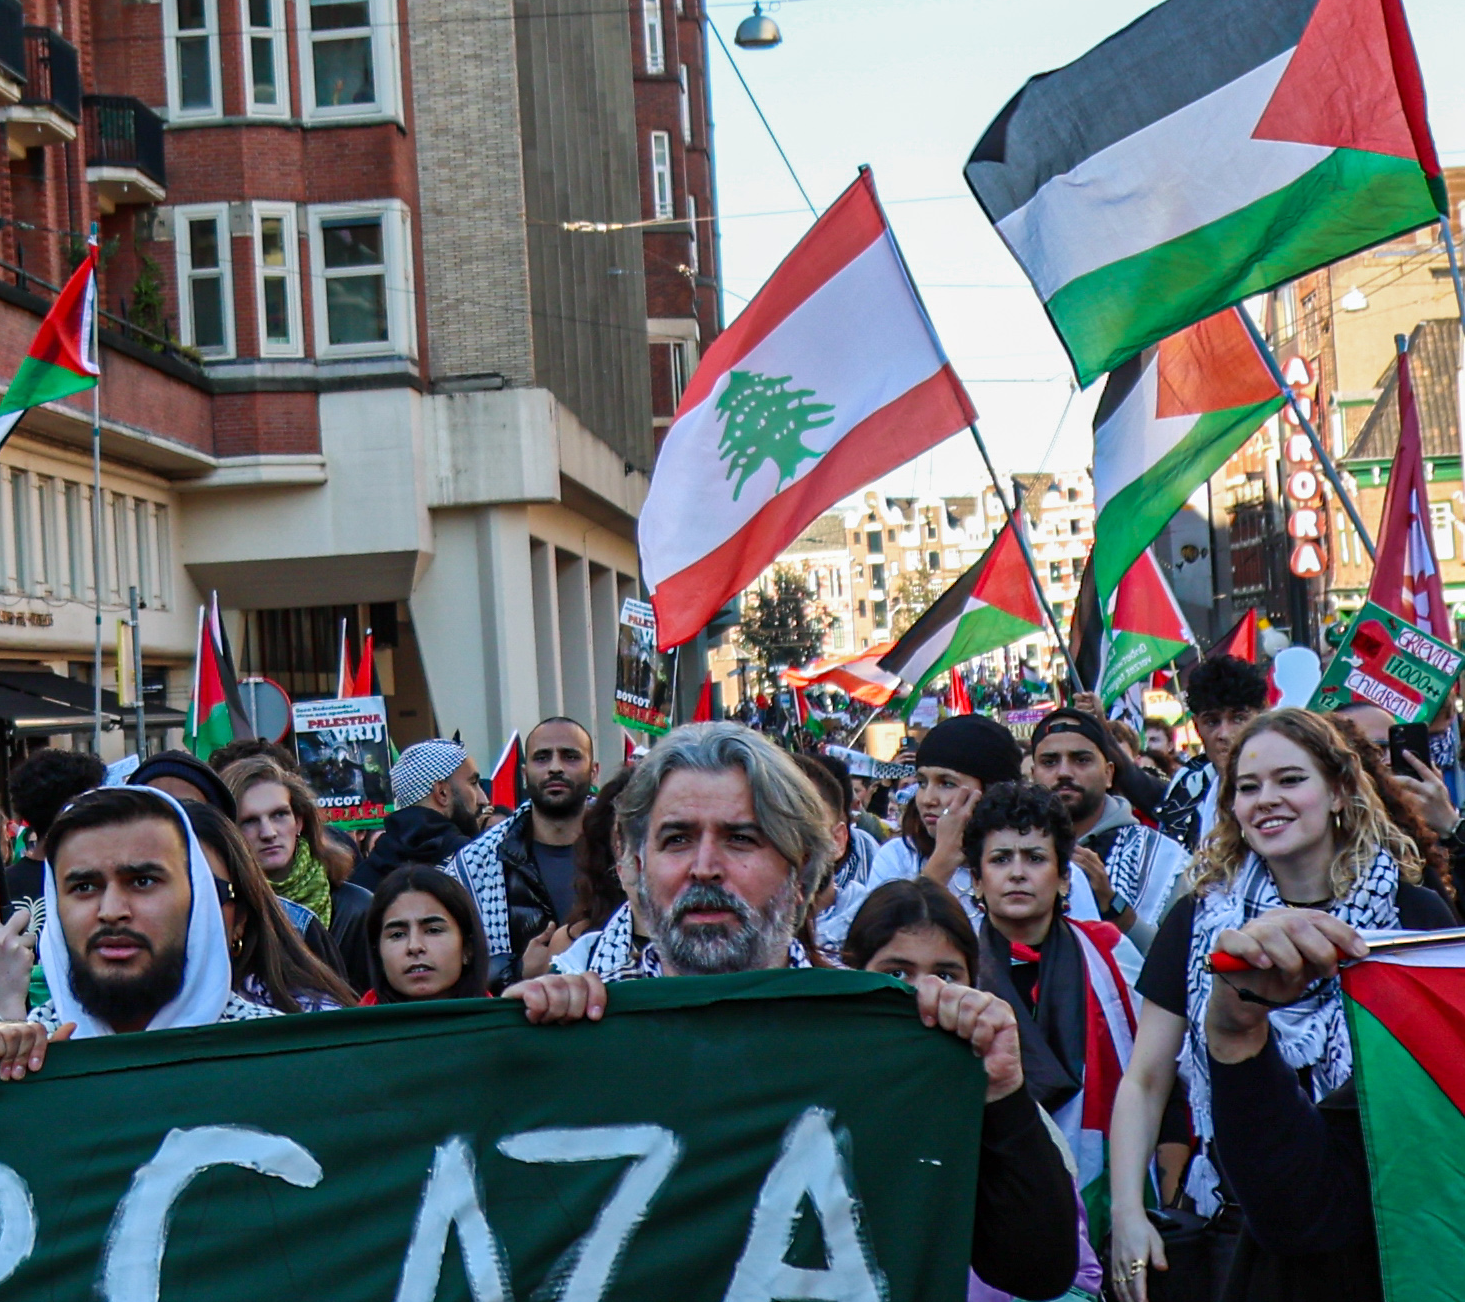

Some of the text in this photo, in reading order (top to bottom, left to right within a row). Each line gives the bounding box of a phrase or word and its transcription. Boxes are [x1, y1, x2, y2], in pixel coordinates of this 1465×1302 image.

[1286, 356, 1322, 573] AURORA
[307, 714, 383, 730] PALESTINA
[332, 724, 383, 744] VRIJ
[316, 795, 362, 808] OYCOT
